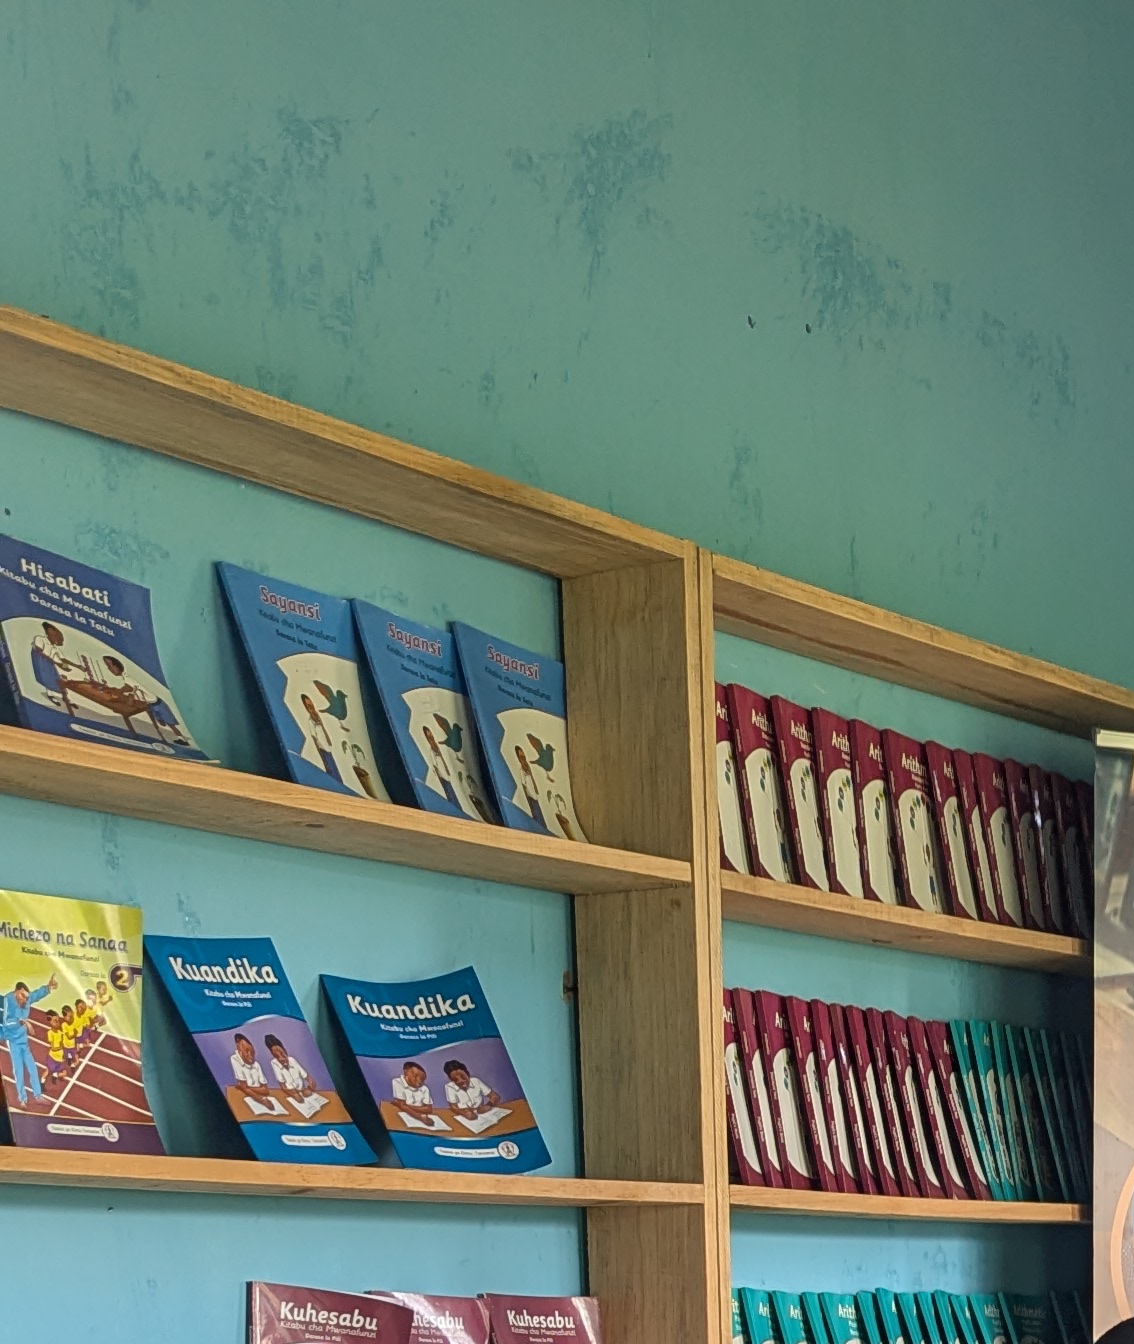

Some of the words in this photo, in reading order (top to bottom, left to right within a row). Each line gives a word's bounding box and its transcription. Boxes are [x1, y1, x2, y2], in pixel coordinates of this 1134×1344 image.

[20, 557, 111, 607] Hisabati
[29, 592, 72, 618] Darasa
[62, 594, 133, 631] Mwanafunzi
[259, 585, 321, 621] Sayansi
[387, 621, 443, 658] Sayansi
[486, 643, 540, 681] Sayansi
[56, 932, 75, 947] na
[80, 931, 129, 953] Sanaa
[114, 968, 130, 987] 2
[168, 956, 279, 984] Kuandika
[346, 993, 476, 1020] Kuandika
[280, 1301, 378, 1331] Kuhesabu
[412, 1309, 465, 1330] hesabu
[506, 1309, 575, 1329] Kuhesabu
